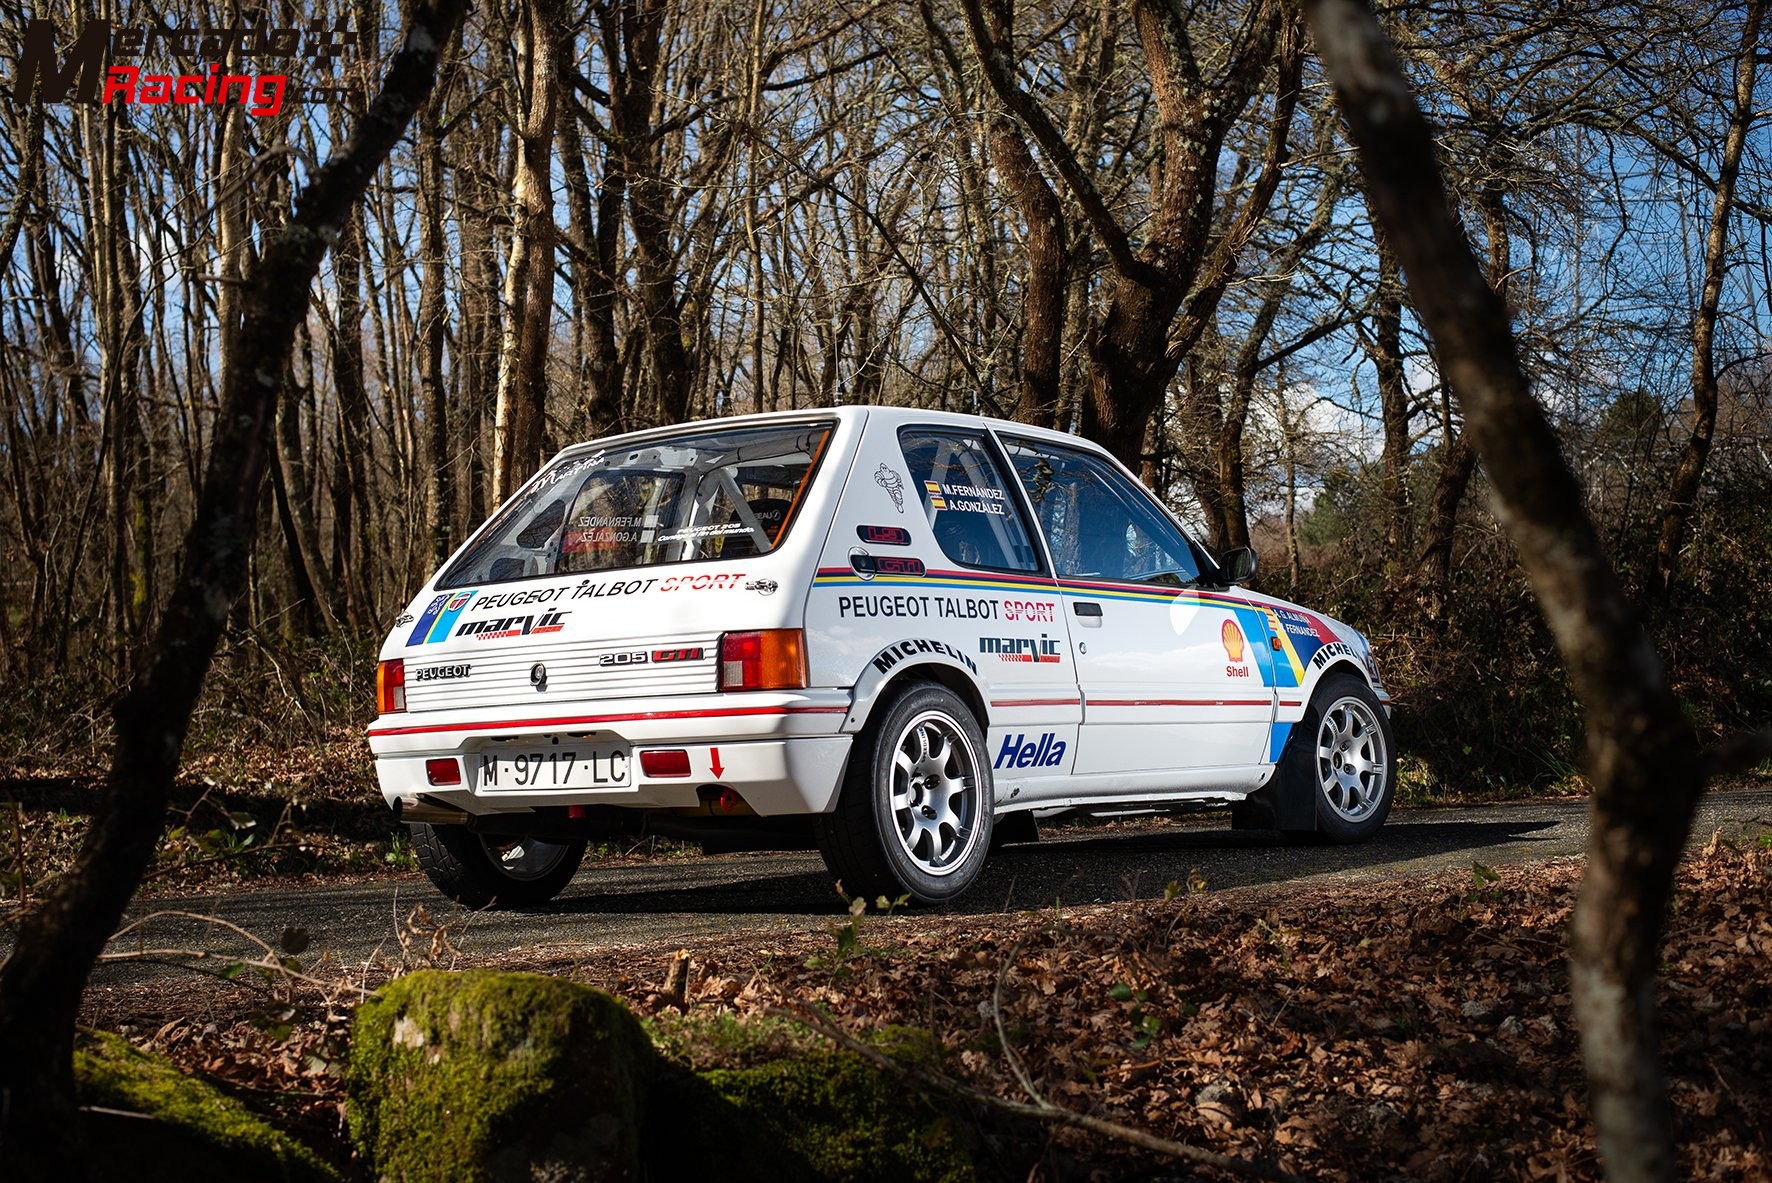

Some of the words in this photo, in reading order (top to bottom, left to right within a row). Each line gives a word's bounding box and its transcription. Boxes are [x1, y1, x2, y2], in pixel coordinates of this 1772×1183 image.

[471, 586, 569, 611] PEUGEOT
[571, 578, 659, 600] TALBOT
[660, 574, 746, 592] SPORT
[455, 607, 572, 635] marvic
[839, 596, 929, 617] PEUGEOT
[934, 598, 998, 619] TALBOT
[1003, 600, 1055, 622] SPORT
[600, 651, 648, 666] 205
[652, 648, 701, 662] GTI
[872, 639, 977, 676] MICHELIN
[979, 633, 1060, 662] marvic
[415, 664, 472, 681] PEUGEOT
[1226, 665, 1249, 677] Shell
[994, 733, 1067, 769] Hella
